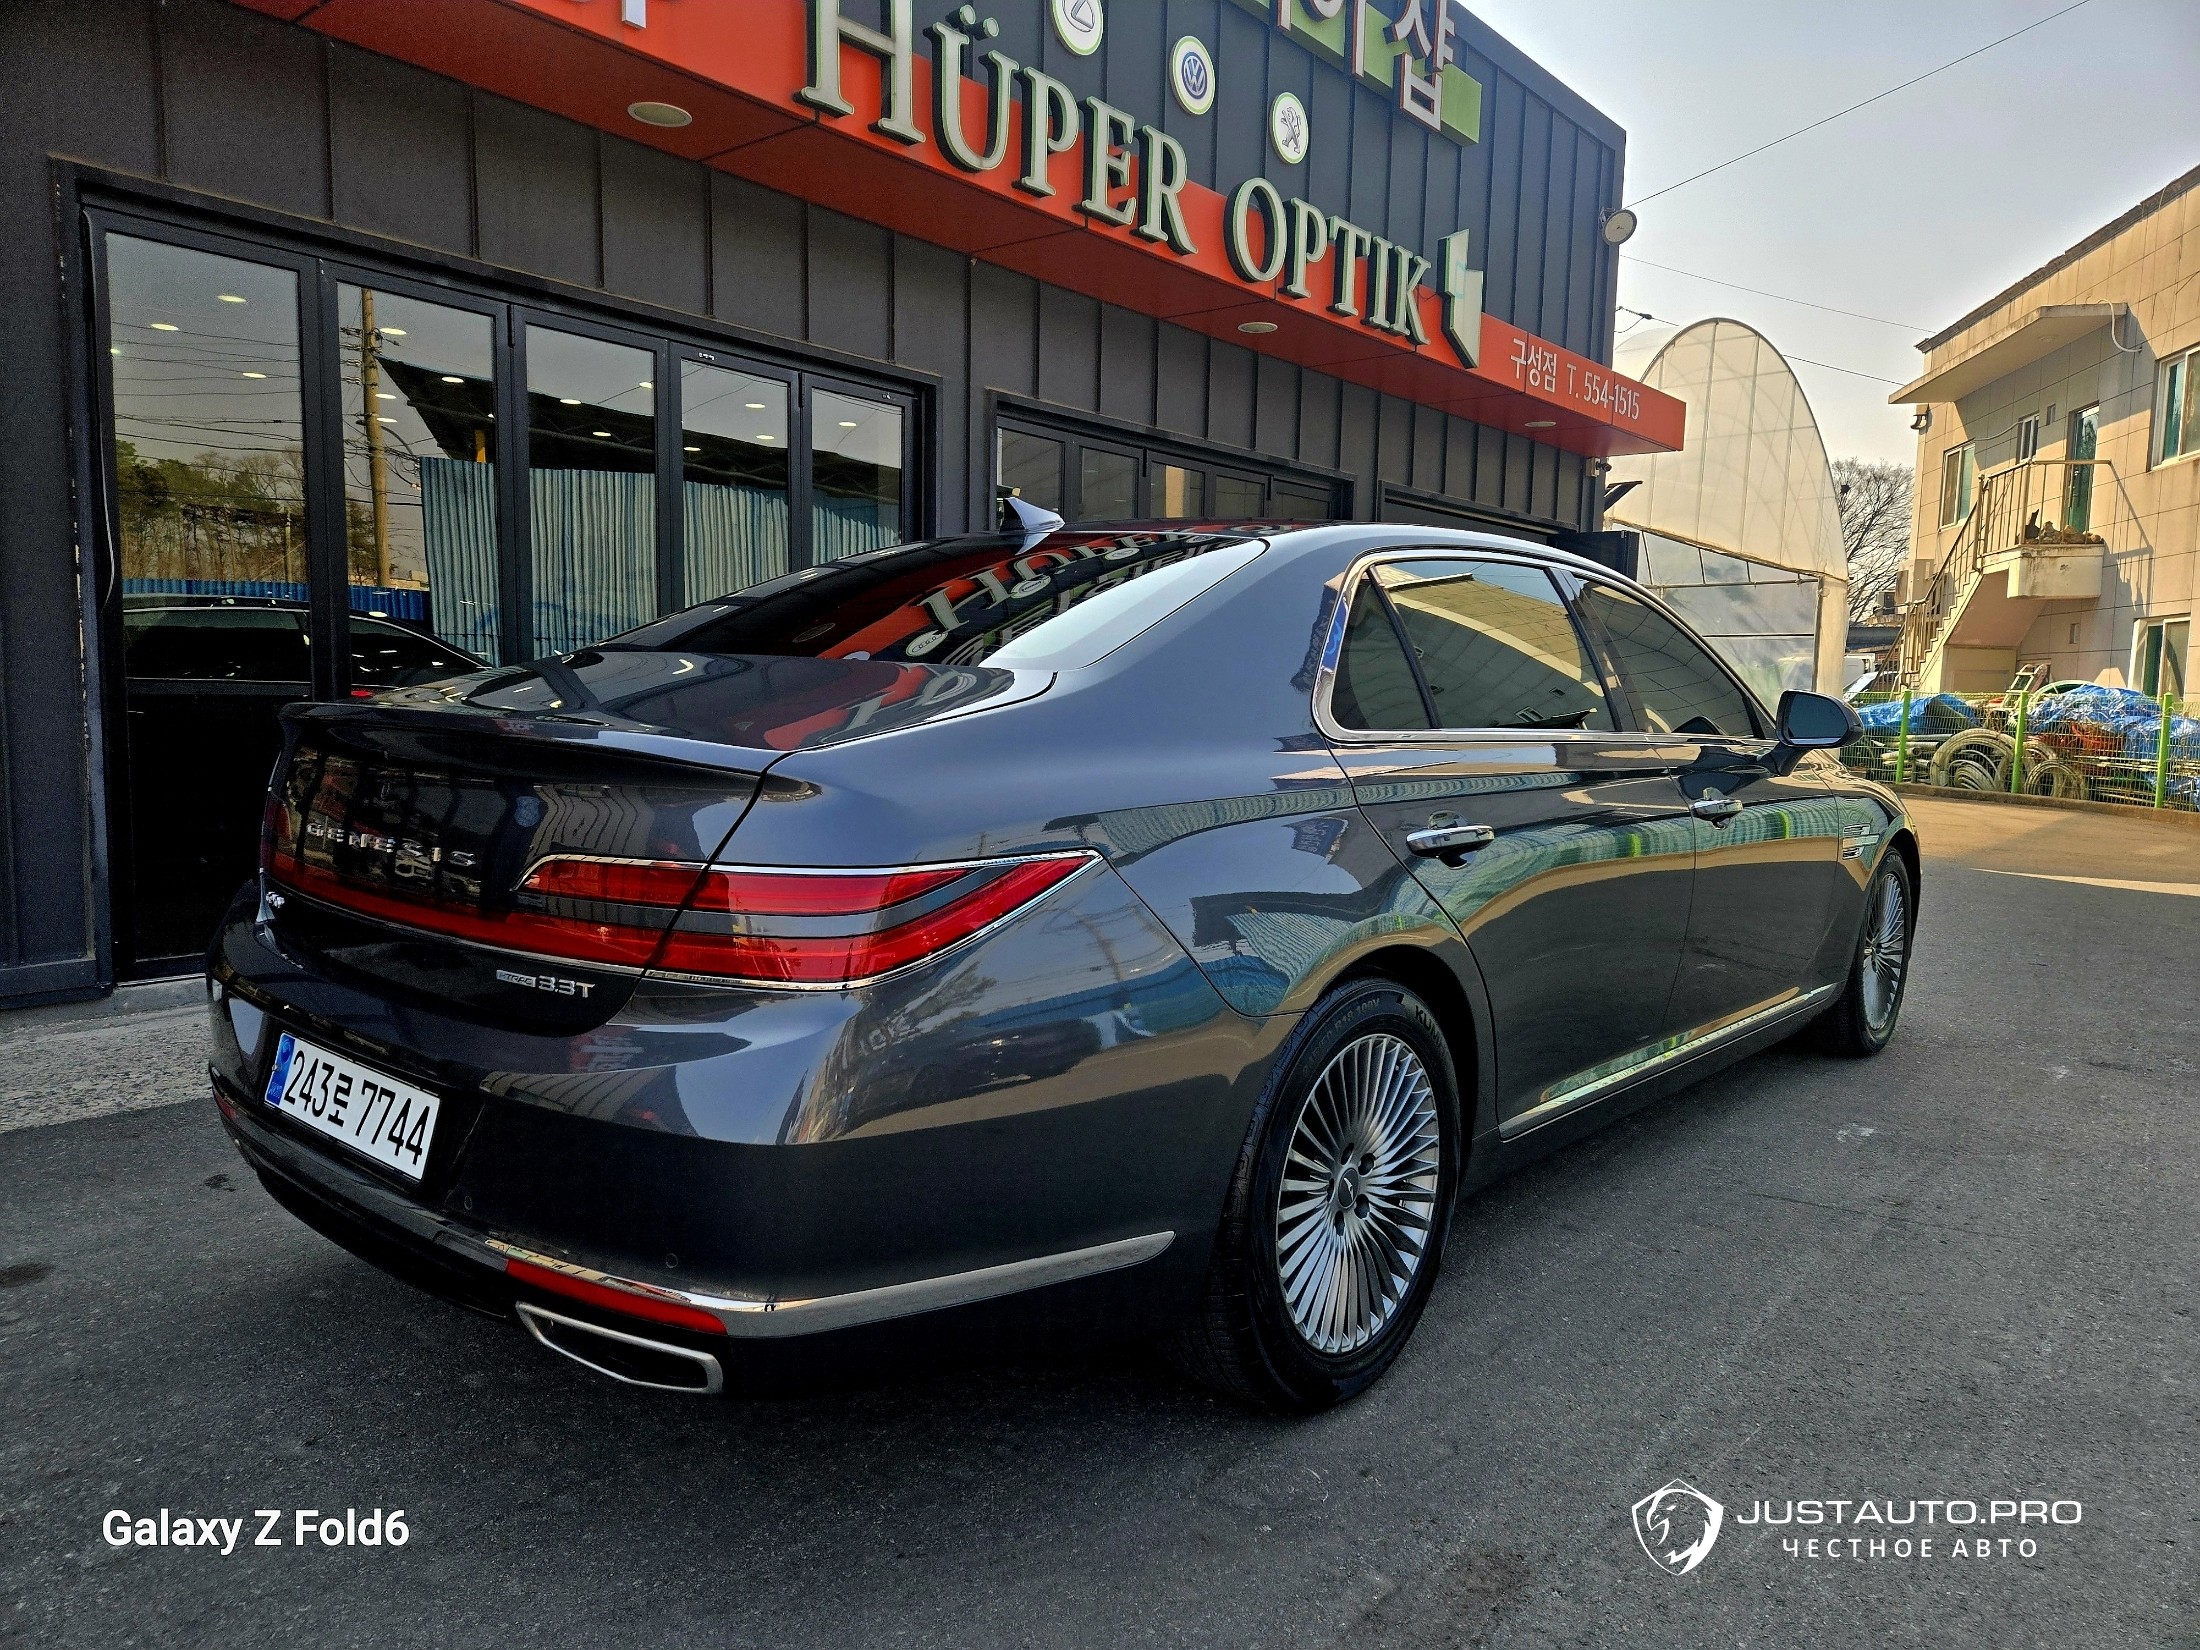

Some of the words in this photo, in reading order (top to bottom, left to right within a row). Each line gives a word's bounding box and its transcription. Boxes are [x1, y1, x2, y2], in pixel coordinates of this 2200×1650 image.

[800, 0, 1197, 254] HÜPER
[1226, 177, 1430, 346] OPTIK
[1511, 338, 1557, 393] 구성점
[1584, 371, 1640, 420] 554-1515
[538, 975, 596, 998] 3.3T
[355, 1079, 430, 1166] 7744
